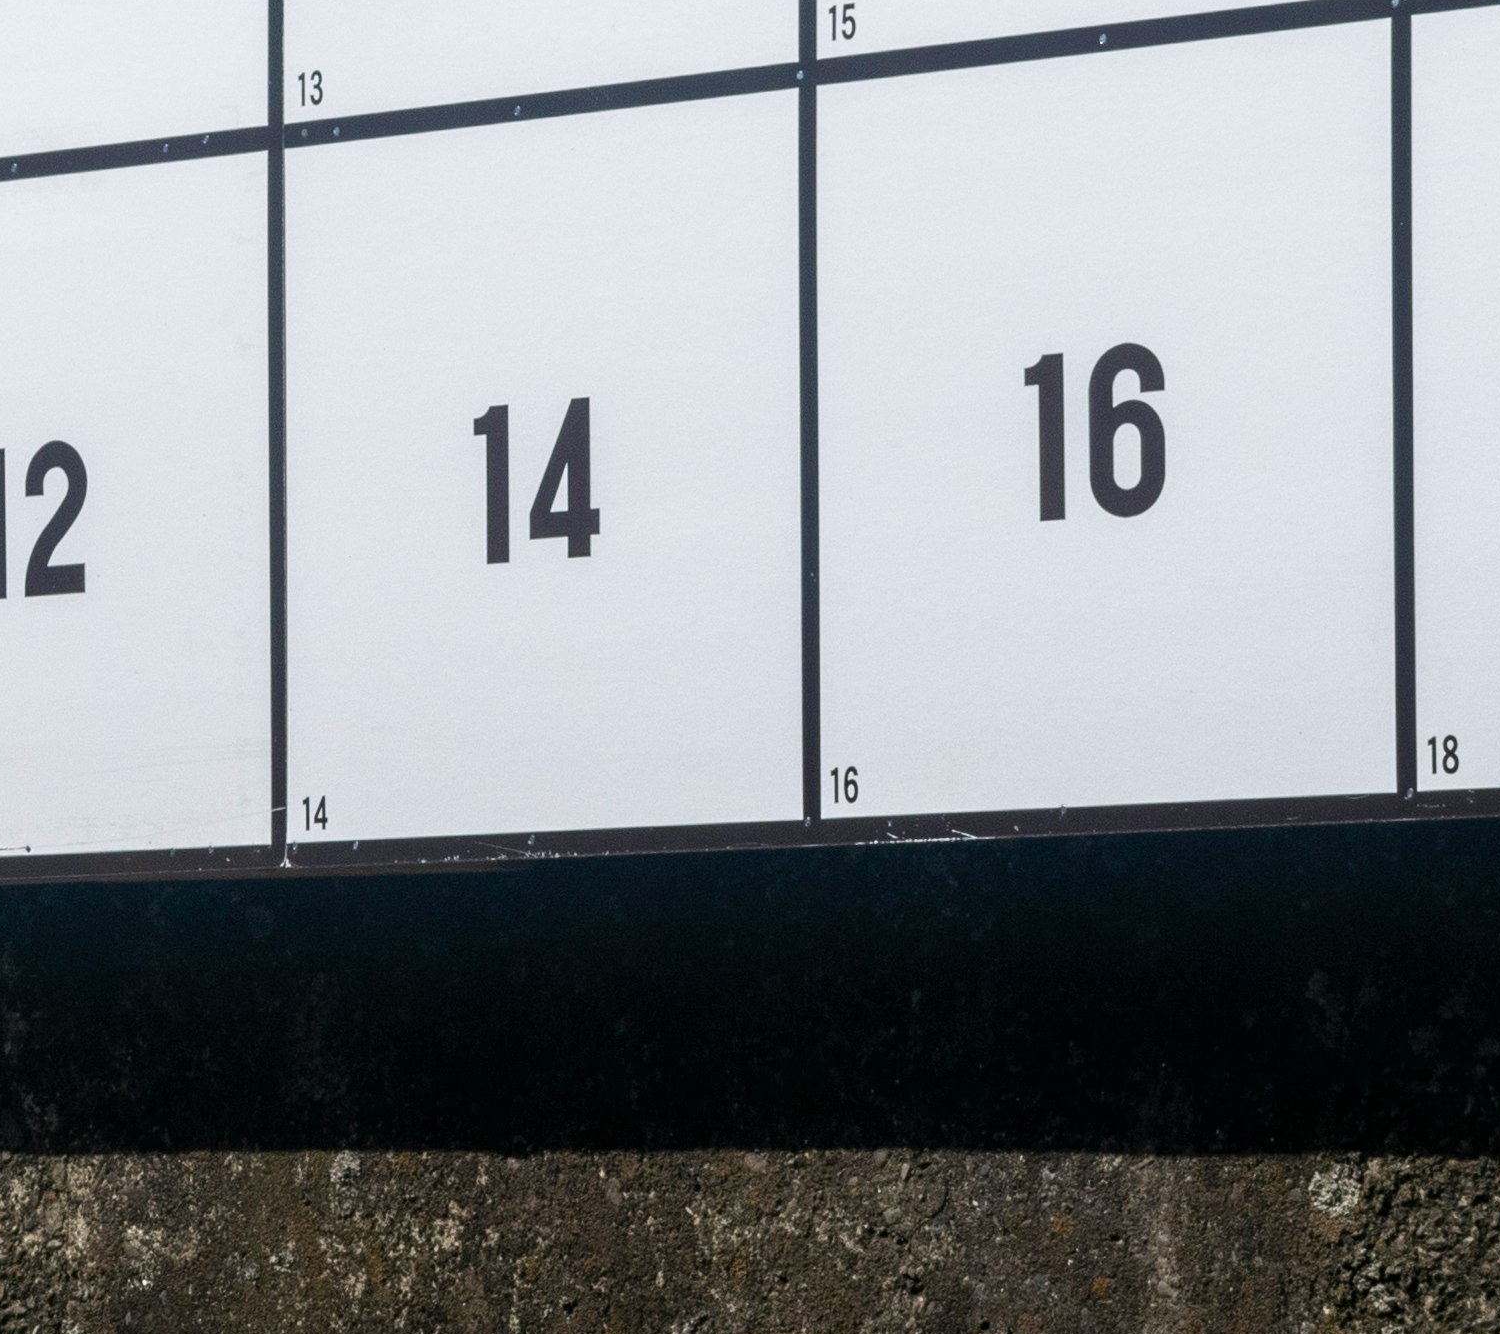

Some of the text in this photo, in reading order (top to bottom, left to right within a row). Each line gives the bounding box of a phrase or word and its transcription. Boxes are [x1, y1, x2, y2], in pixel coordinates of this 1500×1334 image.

[828, 2, 857, 42] 15
[297, 69, 324, 107] 13
[1024, 343, 1166, 522] 16
[473, 397, 600, 564] 14
[1427, 734, 1460, 775] 18
[830, 765, 859, 804] 16
[302, 794, 329, 832] 14
